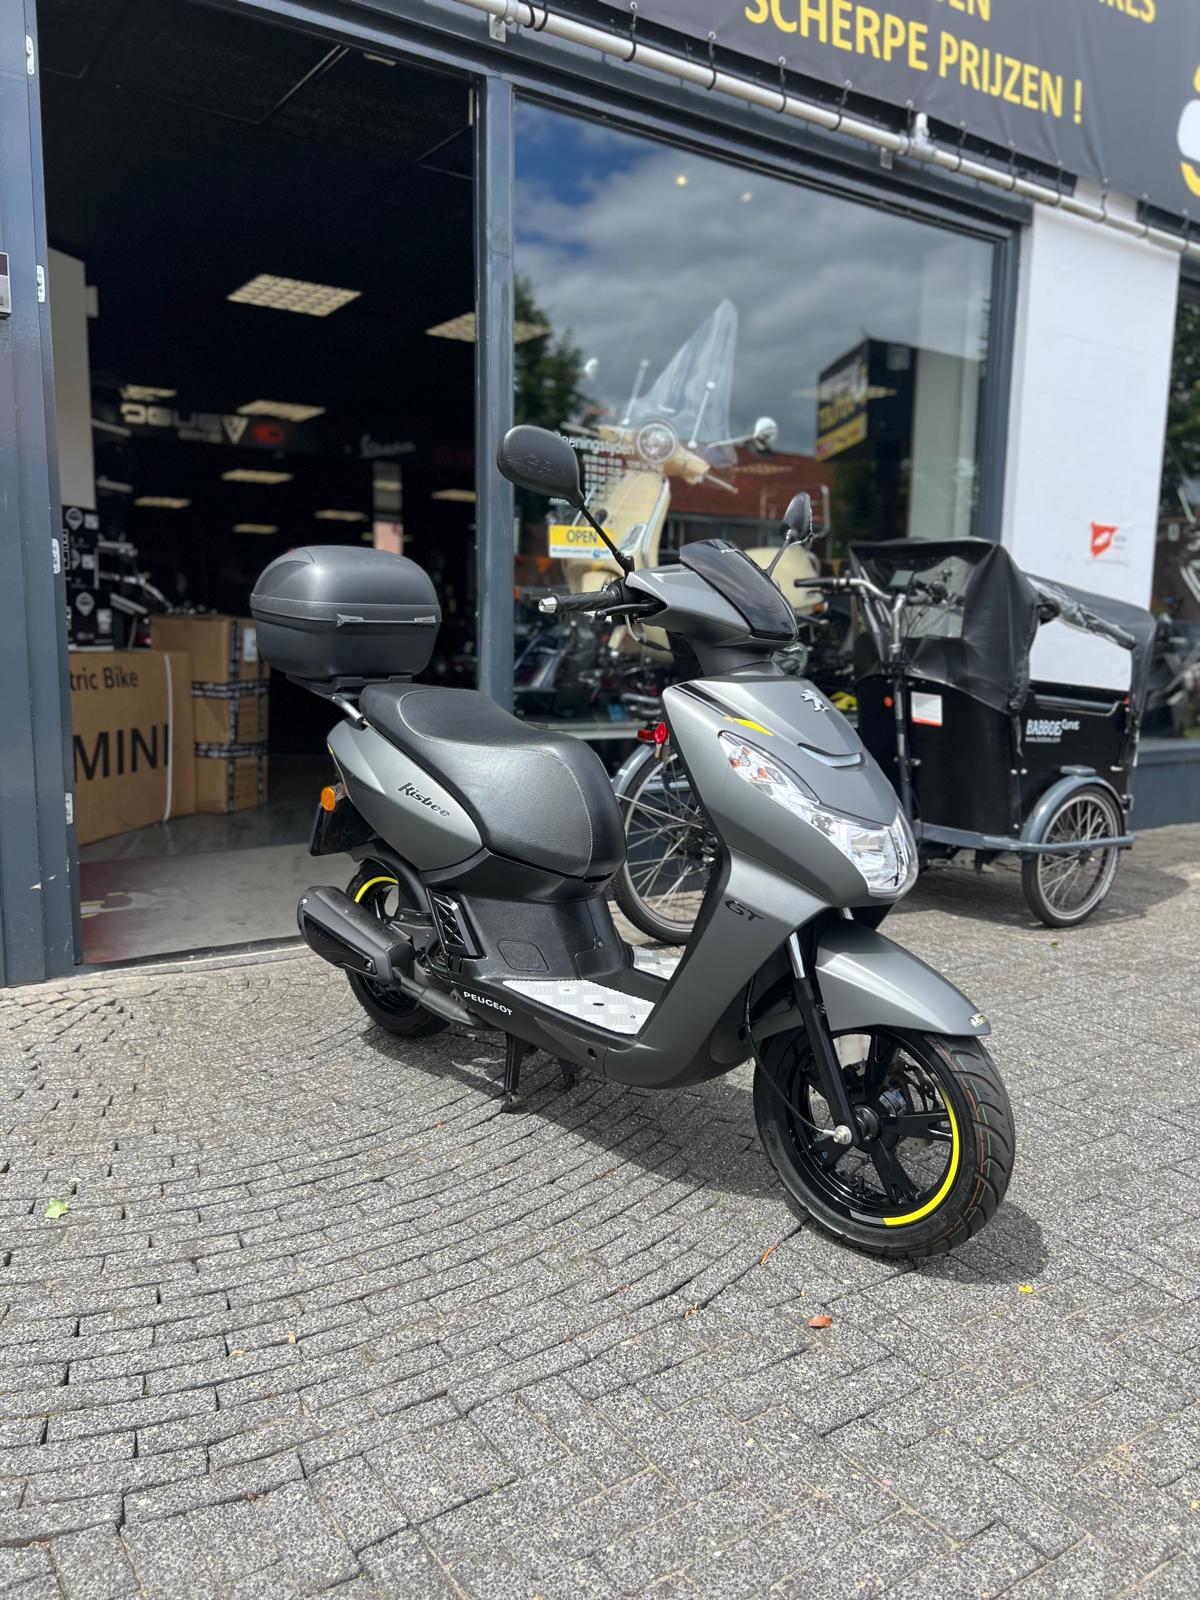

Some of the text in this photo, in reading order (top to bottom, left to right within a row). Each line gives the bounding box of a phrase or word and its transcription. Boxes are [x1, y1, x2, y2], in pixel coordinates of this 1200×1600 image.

[745, 0, 1083, 124] SCHERPE PRIJZEN !
[566, 529, 597, 544] OPEN
[103, 665, 139, 688] Bike
[397, 782, 451, 817] Kisbee
[724, 900, 764, 921] GT
[463, 991, 513, 1016] PEUGEOT
